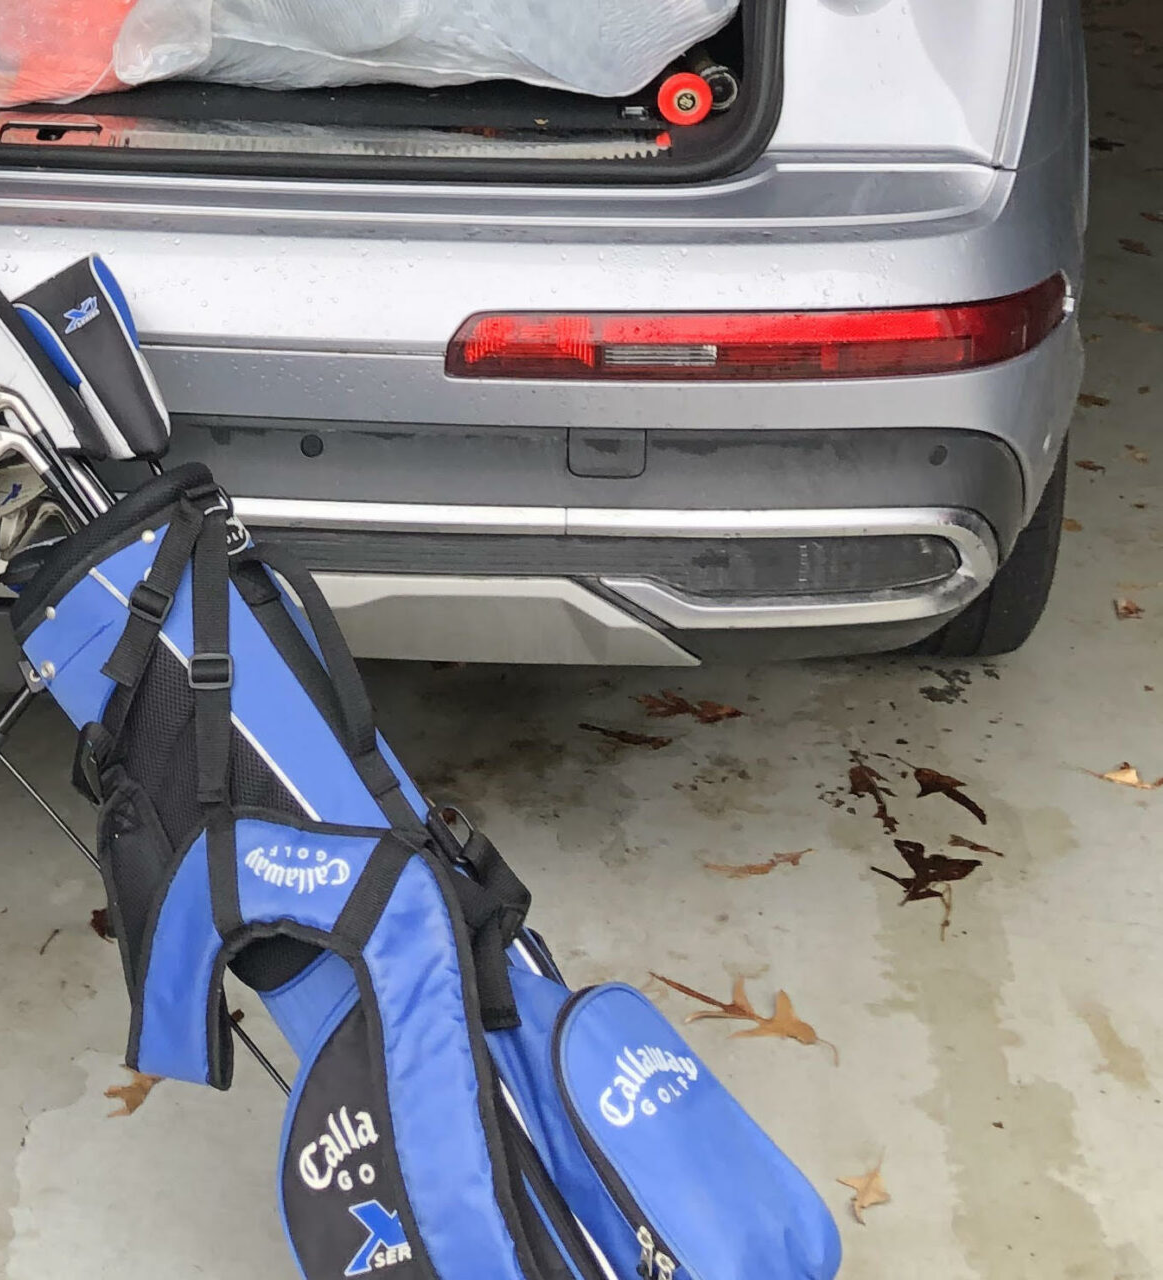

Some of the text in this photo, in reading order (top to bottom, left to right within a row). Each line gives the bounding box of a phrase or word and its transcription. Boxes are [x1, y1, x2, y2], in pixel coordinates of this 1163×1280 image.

[244, 847, 350, 894] Callaway
[269, 845, 327, 862] GOLF
[599, 1044, 698, 1127] Callaway
[640, 1075, 689, 1116] GOLF
